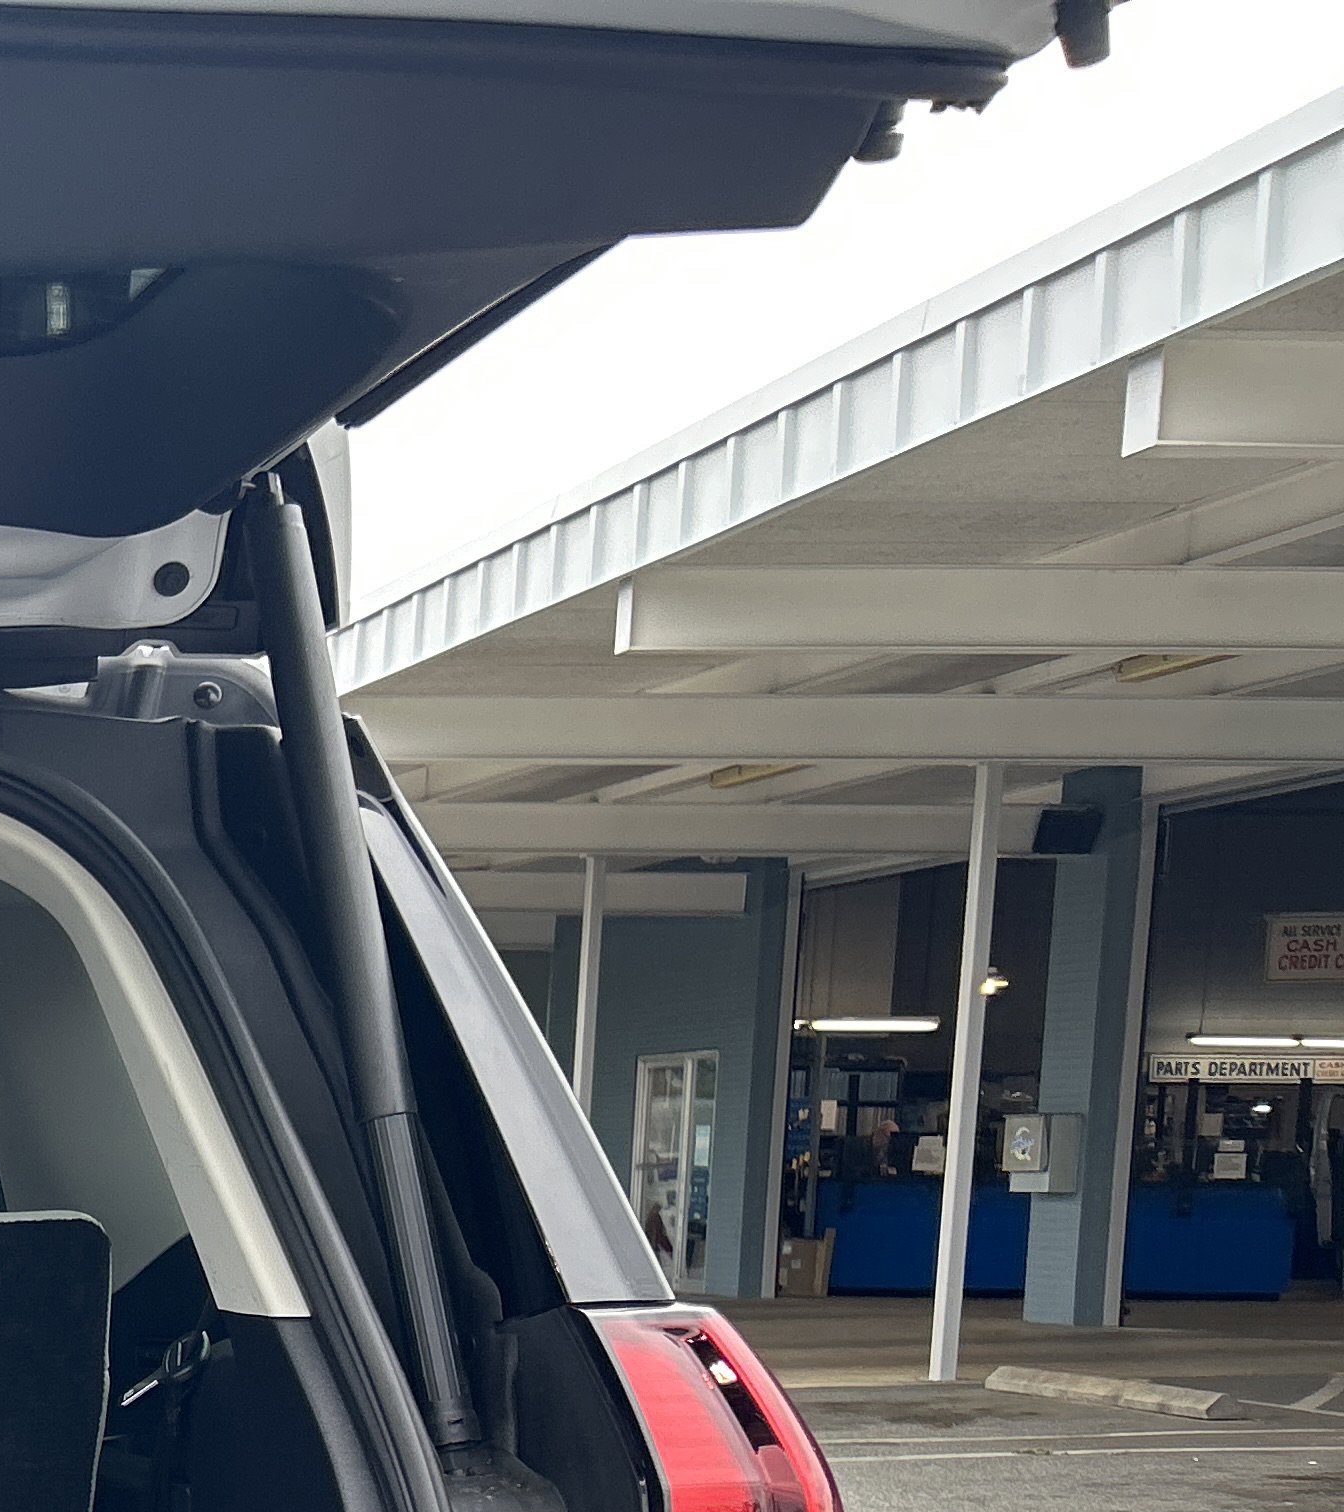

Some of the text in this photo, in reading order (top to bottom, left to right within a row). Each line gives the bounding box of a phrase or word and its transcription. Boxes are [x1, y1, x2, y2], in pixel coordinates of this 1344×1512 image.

[1287, 939, 1337, 952] CASH
[1278, 954, 1330, 970] CREDIT
[1156, 1060, 1311, 1077] PARTS DEPARTMENT
